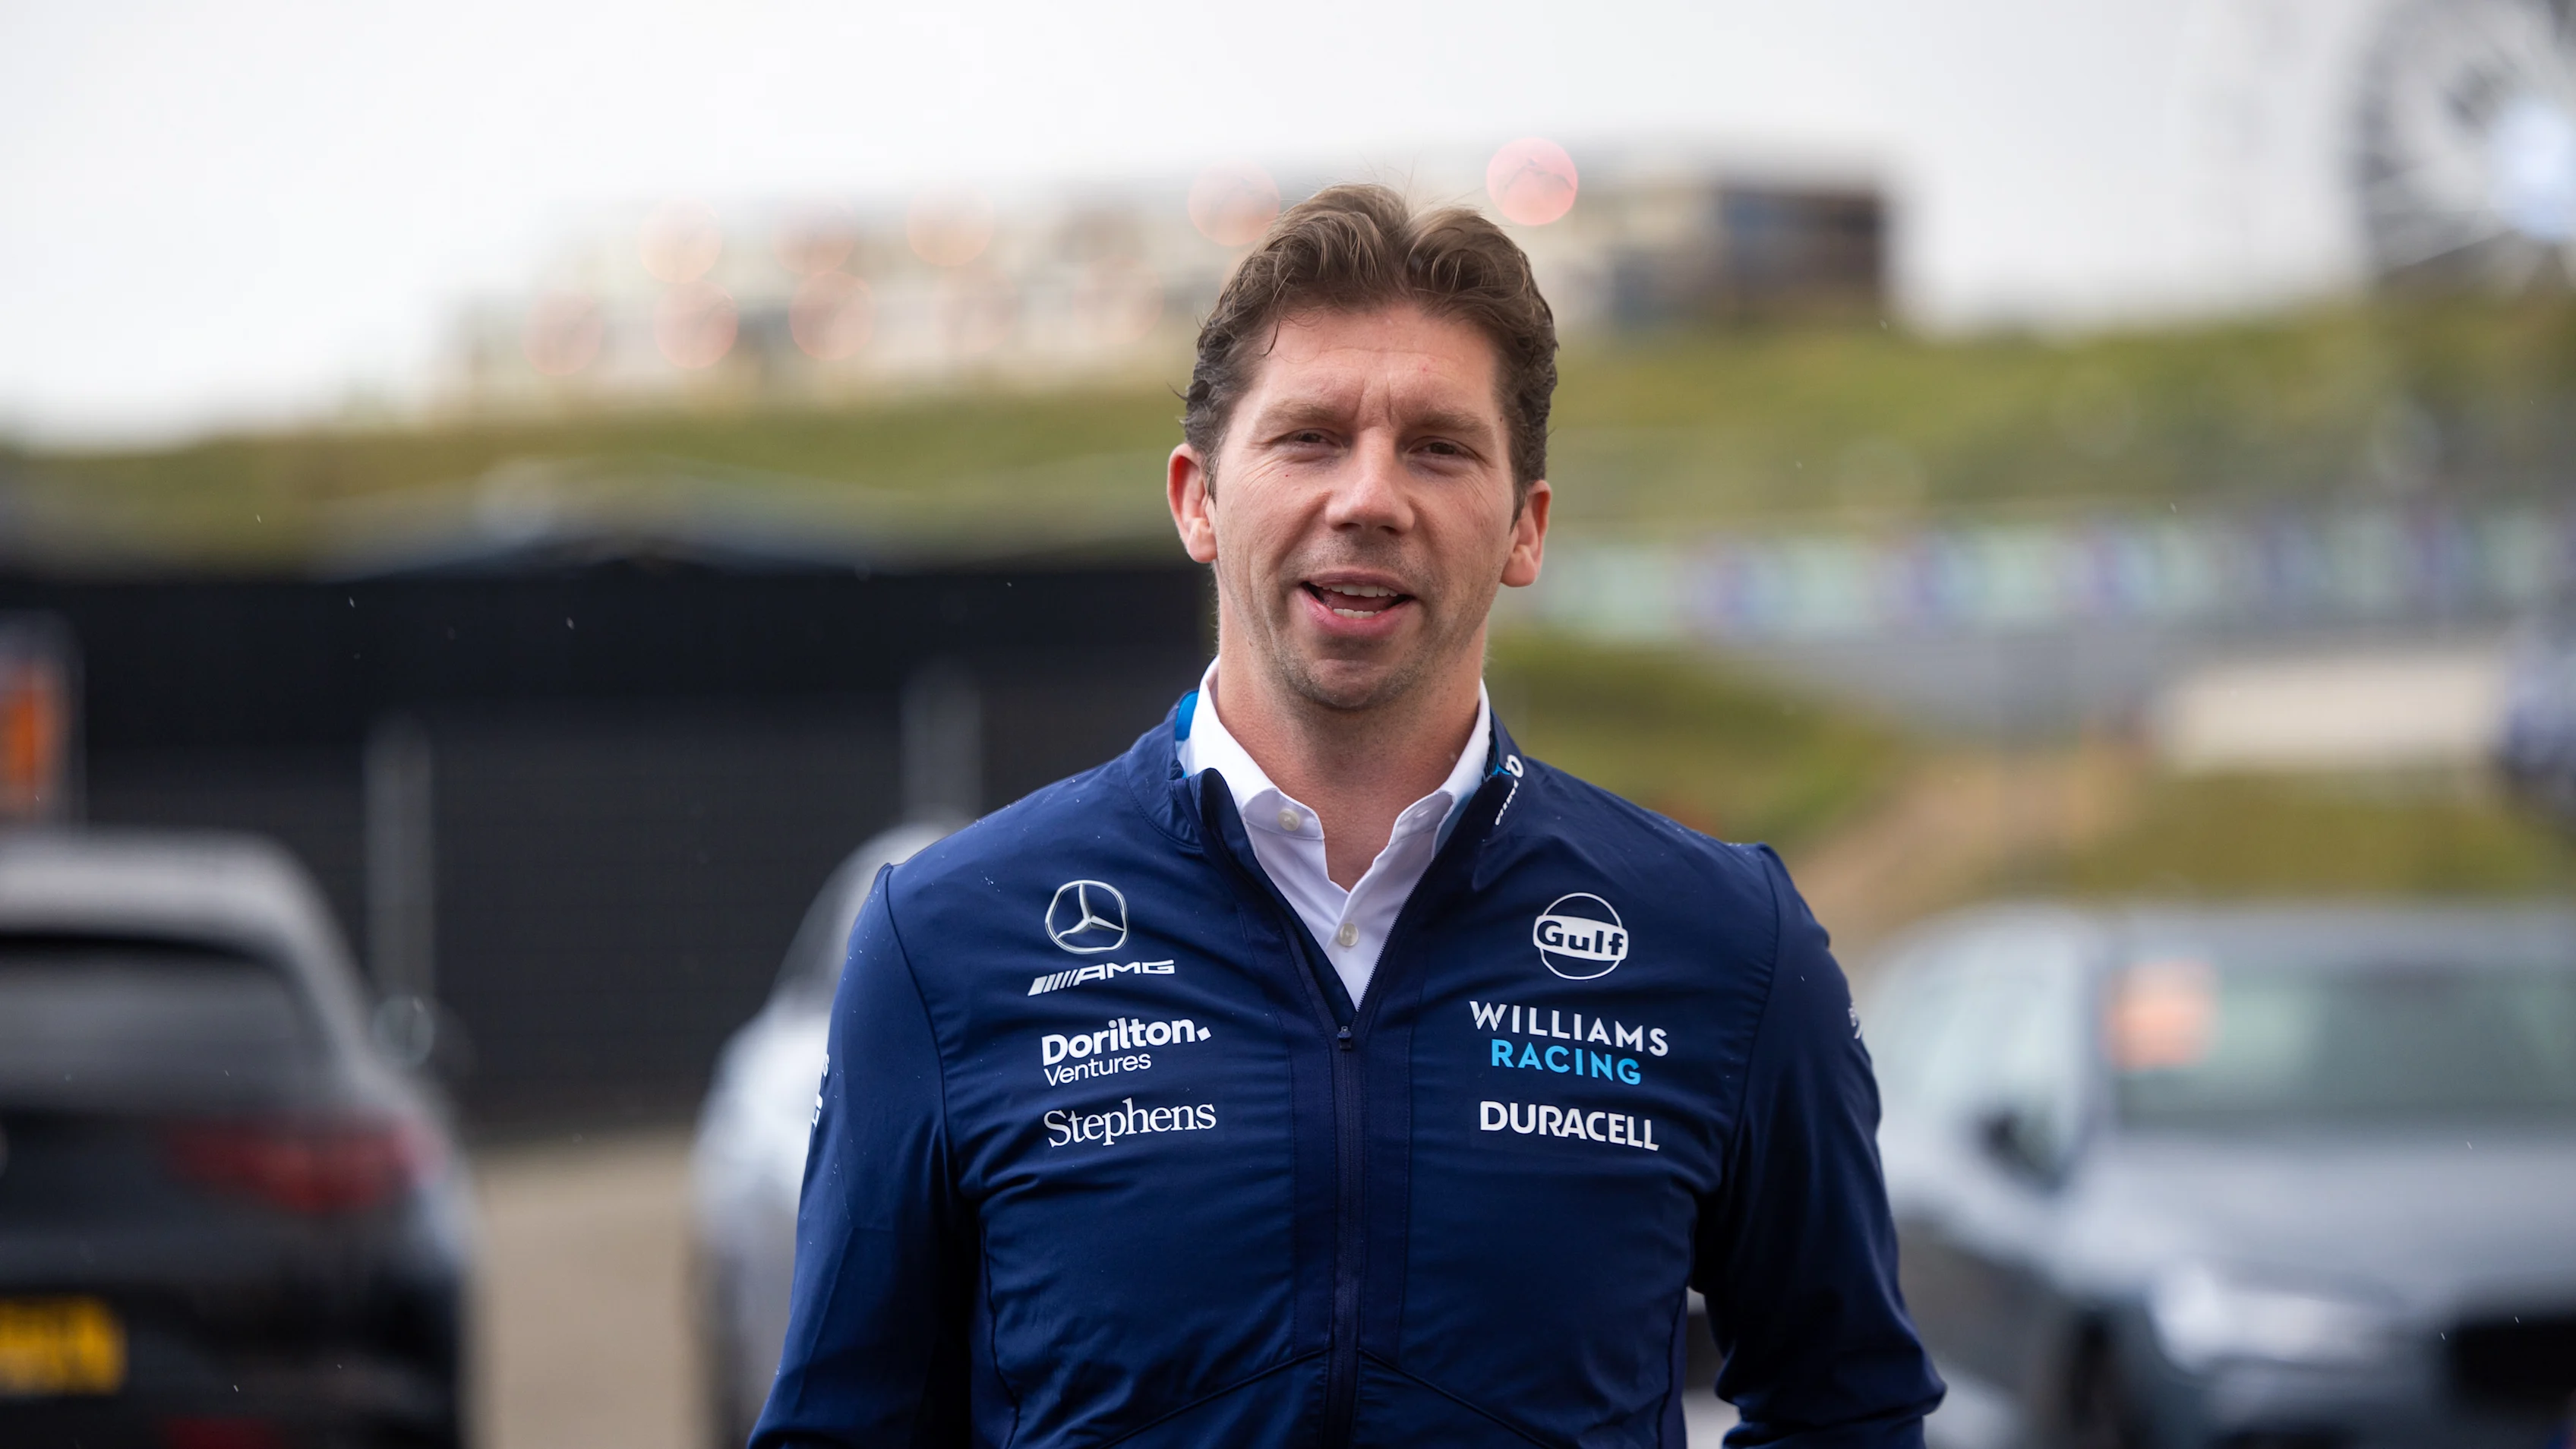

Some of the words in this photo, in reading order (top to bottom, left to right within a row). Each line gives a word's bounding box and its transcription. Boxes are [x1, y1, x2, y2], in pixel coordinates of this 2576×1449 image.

[1536, 920, 1624, 956] Gulf
[1072, 959, 1175, 987] AMG
[1469, 1000, 1668, 1057] WILLIAMS
[1043, 1053, 1152, 1087] Ventures
[1491, 1038, 1641, 1085] RACING
[1043, 1097, 1217, 1148] Stephens
[1480, 1100, 1660, 1151] DURACELL
